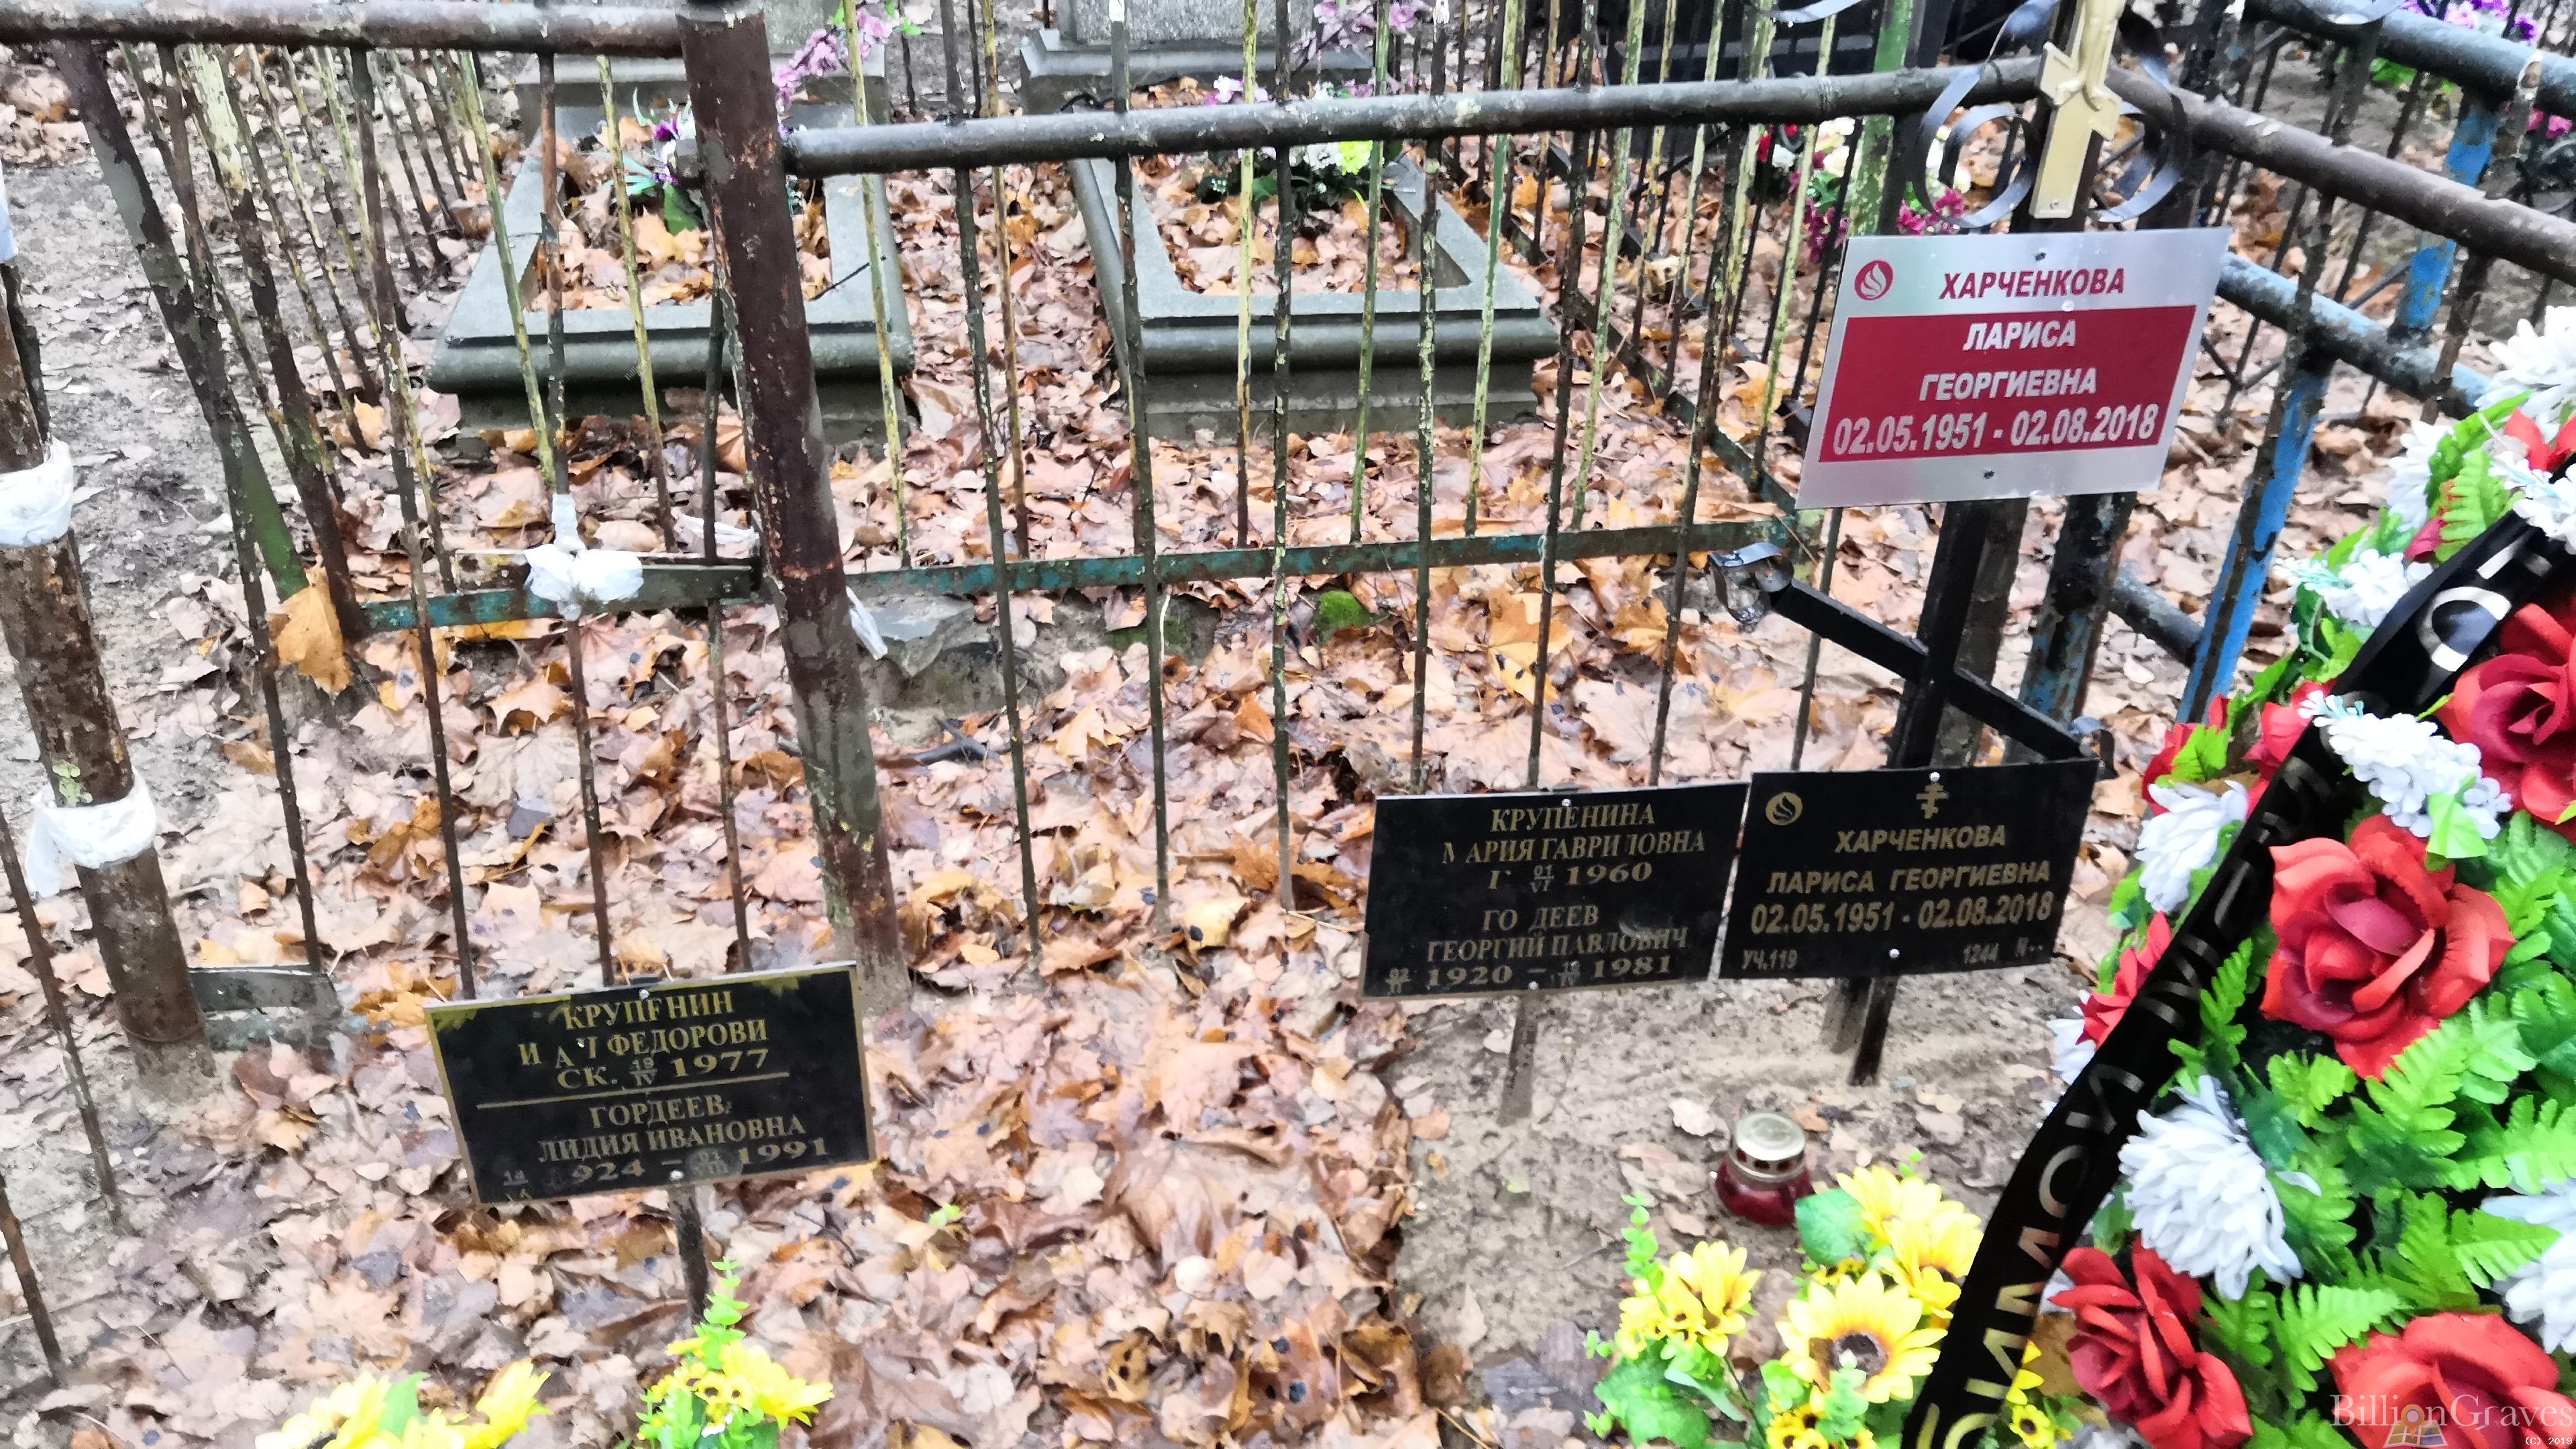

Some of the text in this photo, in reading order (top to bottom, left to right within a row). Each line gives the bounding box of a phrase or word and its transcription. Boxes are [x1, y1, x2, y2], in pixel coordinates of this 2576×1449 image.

[1939, 268, 2125, 299] ХАРЧЕНКОВА
[1963, 319, 2076, 351] ЛАРИСА
[1919, 368, 2096, 401] ГЕОРГИЕВНА
[1833, 412, 1987, 455] 02.05.1951
[2010, 404, 2159, 445] 02.08.2018
[1491, 803, 1655, 833] КРУПЕНИНА
[1835, 825, 2006, 854] ХАРЧЕНКОВА
[1566, 861, 1652, 885] 1960
[1766, 861, 2050, 895] ЛАРИСА ГЕОРГИЕВНА
[1483, 905, 1599, 933] ГОДЕЕВ
[1751, 902, 1894, 934] 02.05.1951
[1918, 891, 2054, 930] 02.08.2018
[1429, 965, 1513, 987] 1920
[1593, 955, 1671, 978] 1981
[607, 1019, 769, 1059] ФЕДОРОВИ
[671, 1048, 769, 1077] 1977
[589, 1094, 733, 1129] ГОРДЕЕВ
[538, 1114, 806, 1163] ЛИДИЯ ИВАНОВНА
[572, 1159, 645, 1185] 924
[738, 1137, 826, 1166] 1991
